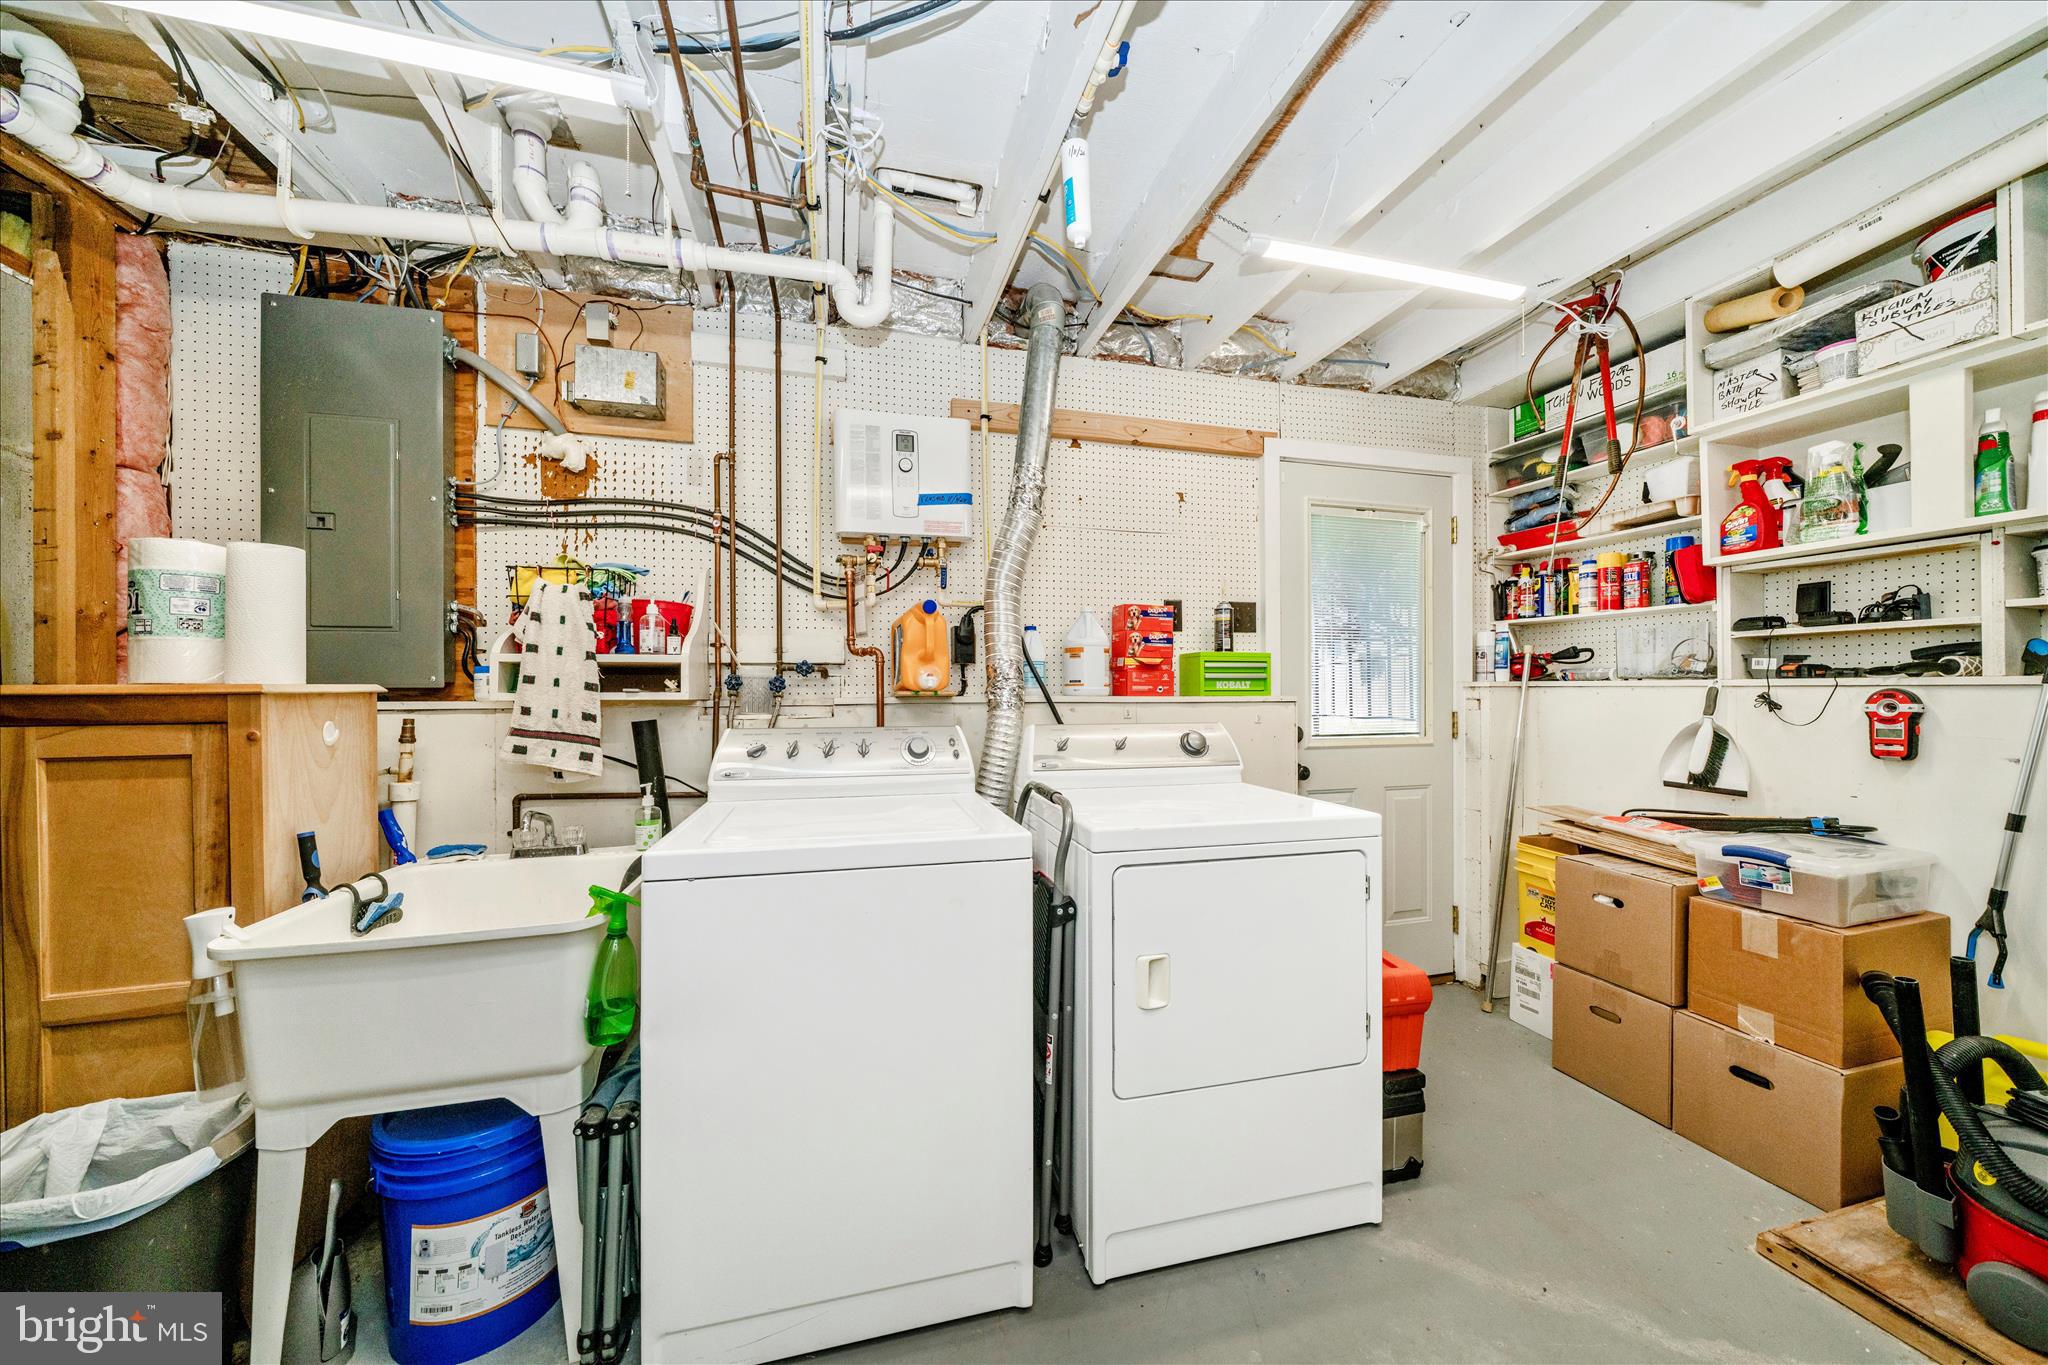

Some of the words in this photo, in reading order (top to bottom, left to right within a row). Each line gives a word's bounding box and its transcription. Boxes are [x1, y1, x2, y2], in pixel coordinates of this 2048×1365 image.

[1862, 288, 1933, 322] KITCHEN
[1869, 298, 1933, 327] SUBWAY
[1903, 298, 1956, 321] TILES
[1717, 368, 1759, 389] MASTER
[1718, 382, 1744, 400] BATH
[1721, 387, 1766, 410] SHOWER
[1735, 399, 1763, 413] TILE
[1725, 517, 1749, 532] Sevin
[1215, 680, 1251, 689] KOBALT
[495, 1224, 521, 1240] Tankless
[523, 1213, 539, 1226] Water
[510, 1223, 535, 1240] Descaler
[537, 1216, 545, 1225] Kit
